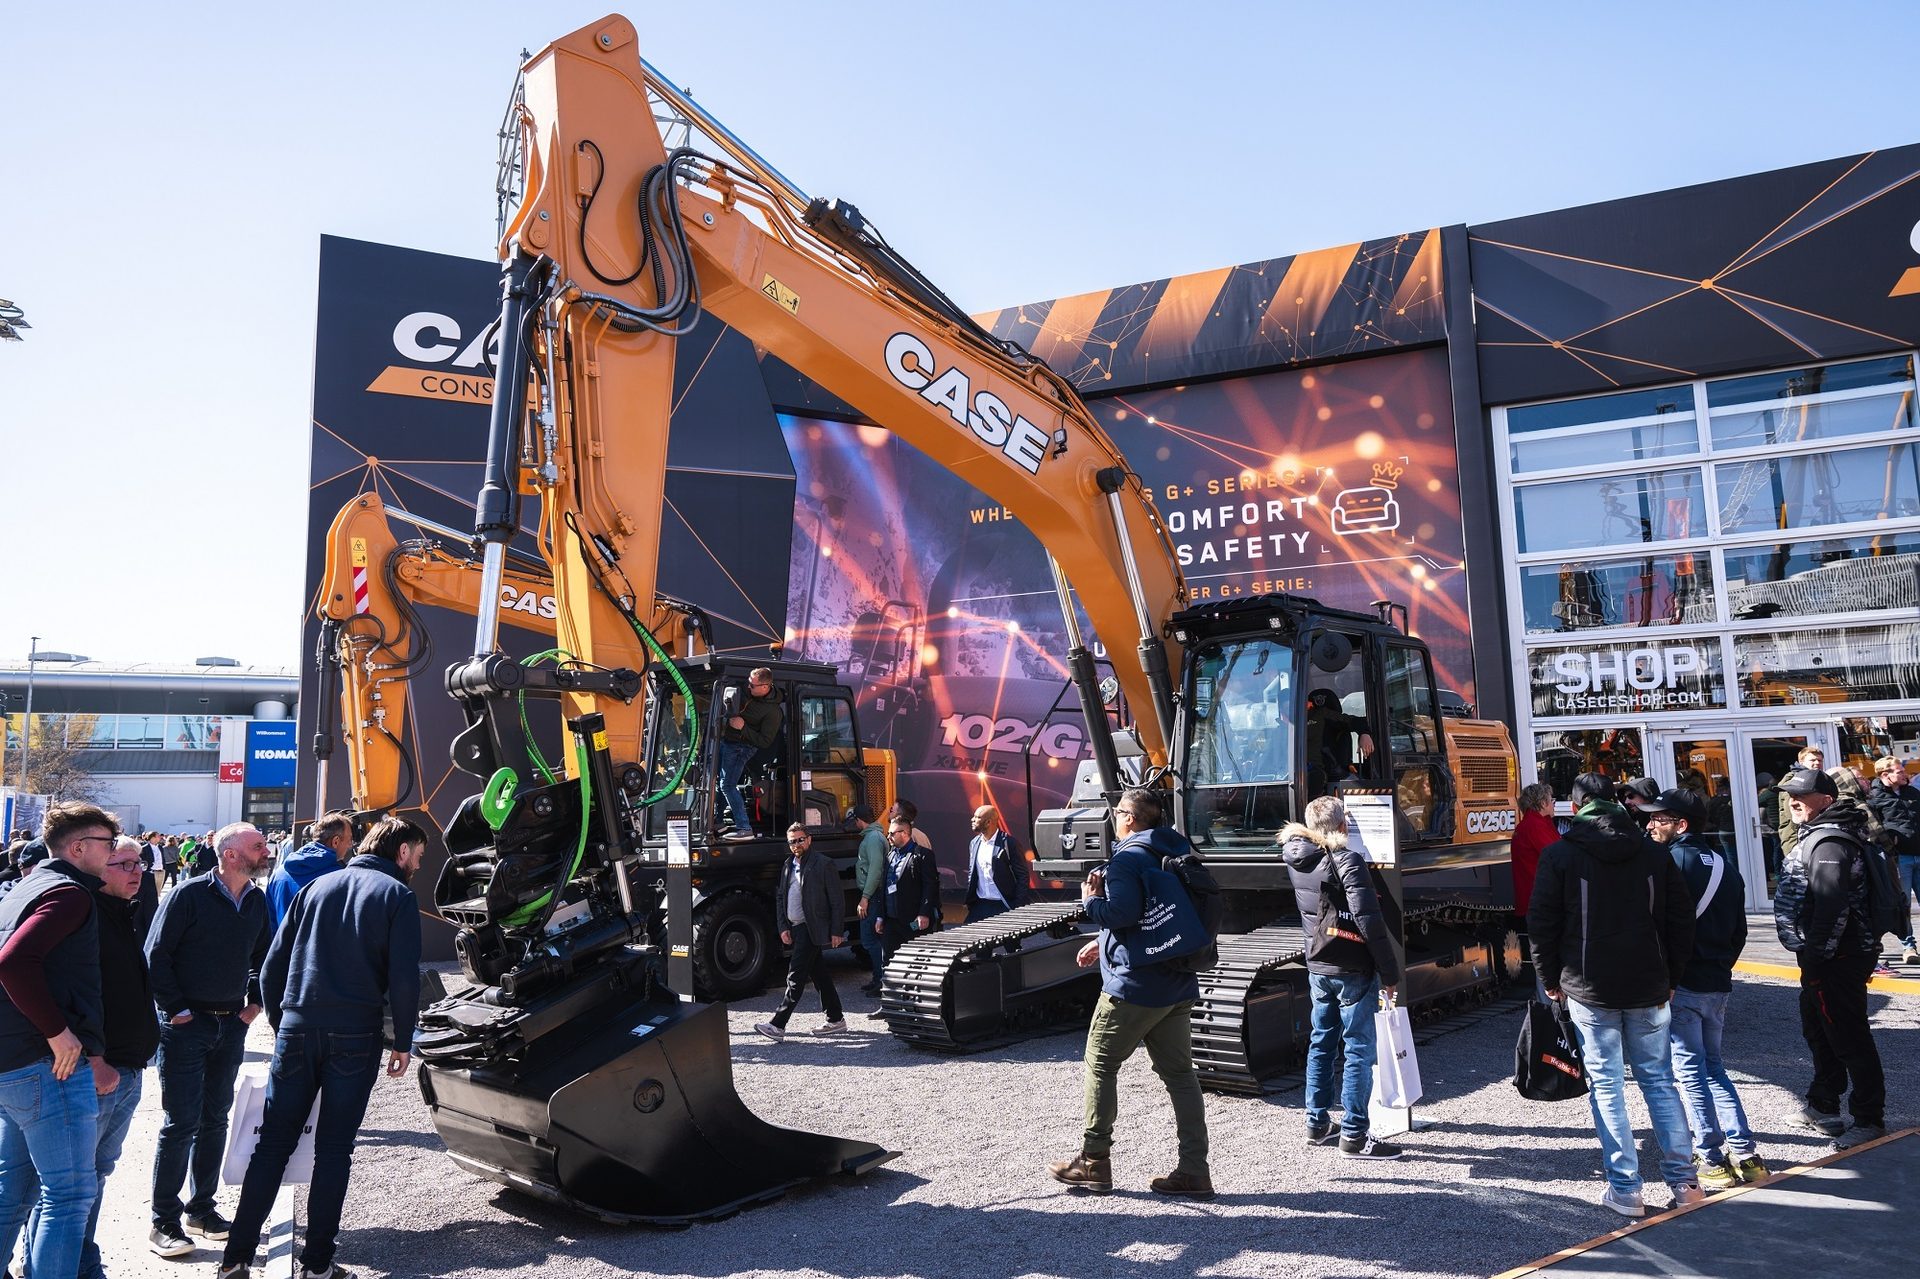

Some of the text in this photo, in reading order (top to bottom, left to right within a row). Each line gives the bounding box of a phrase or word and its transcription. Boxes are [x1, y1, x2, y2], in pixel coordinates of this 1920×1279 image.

[393, 312, 501, 368] CA
[421, 375, 495, 399] CONS
[884, 332, 1051, 476] CASE
[970, 507, 1013, 524] WHE
[1166, 485, 1194, 500] G+
[1207, 469, 1306, 495] SERIES:
[1166, 496, 1308, 534] OMFORT
[1176, 531, 1311, 566] SAFETY
[500, 584, 557, 619] CAS
[1220, 584, 1242, 597] G+
[1252, 578, 1313, 595] SERIE:
[1554, 646, 1698, 694] SHOP
[1556, 691, 1703, 709] CASECESHOP.COM
[229, 768, 243, 776] C6
[1466, 809, 1516, 834] CX250E
[671, 944, 690, 953] CASE
